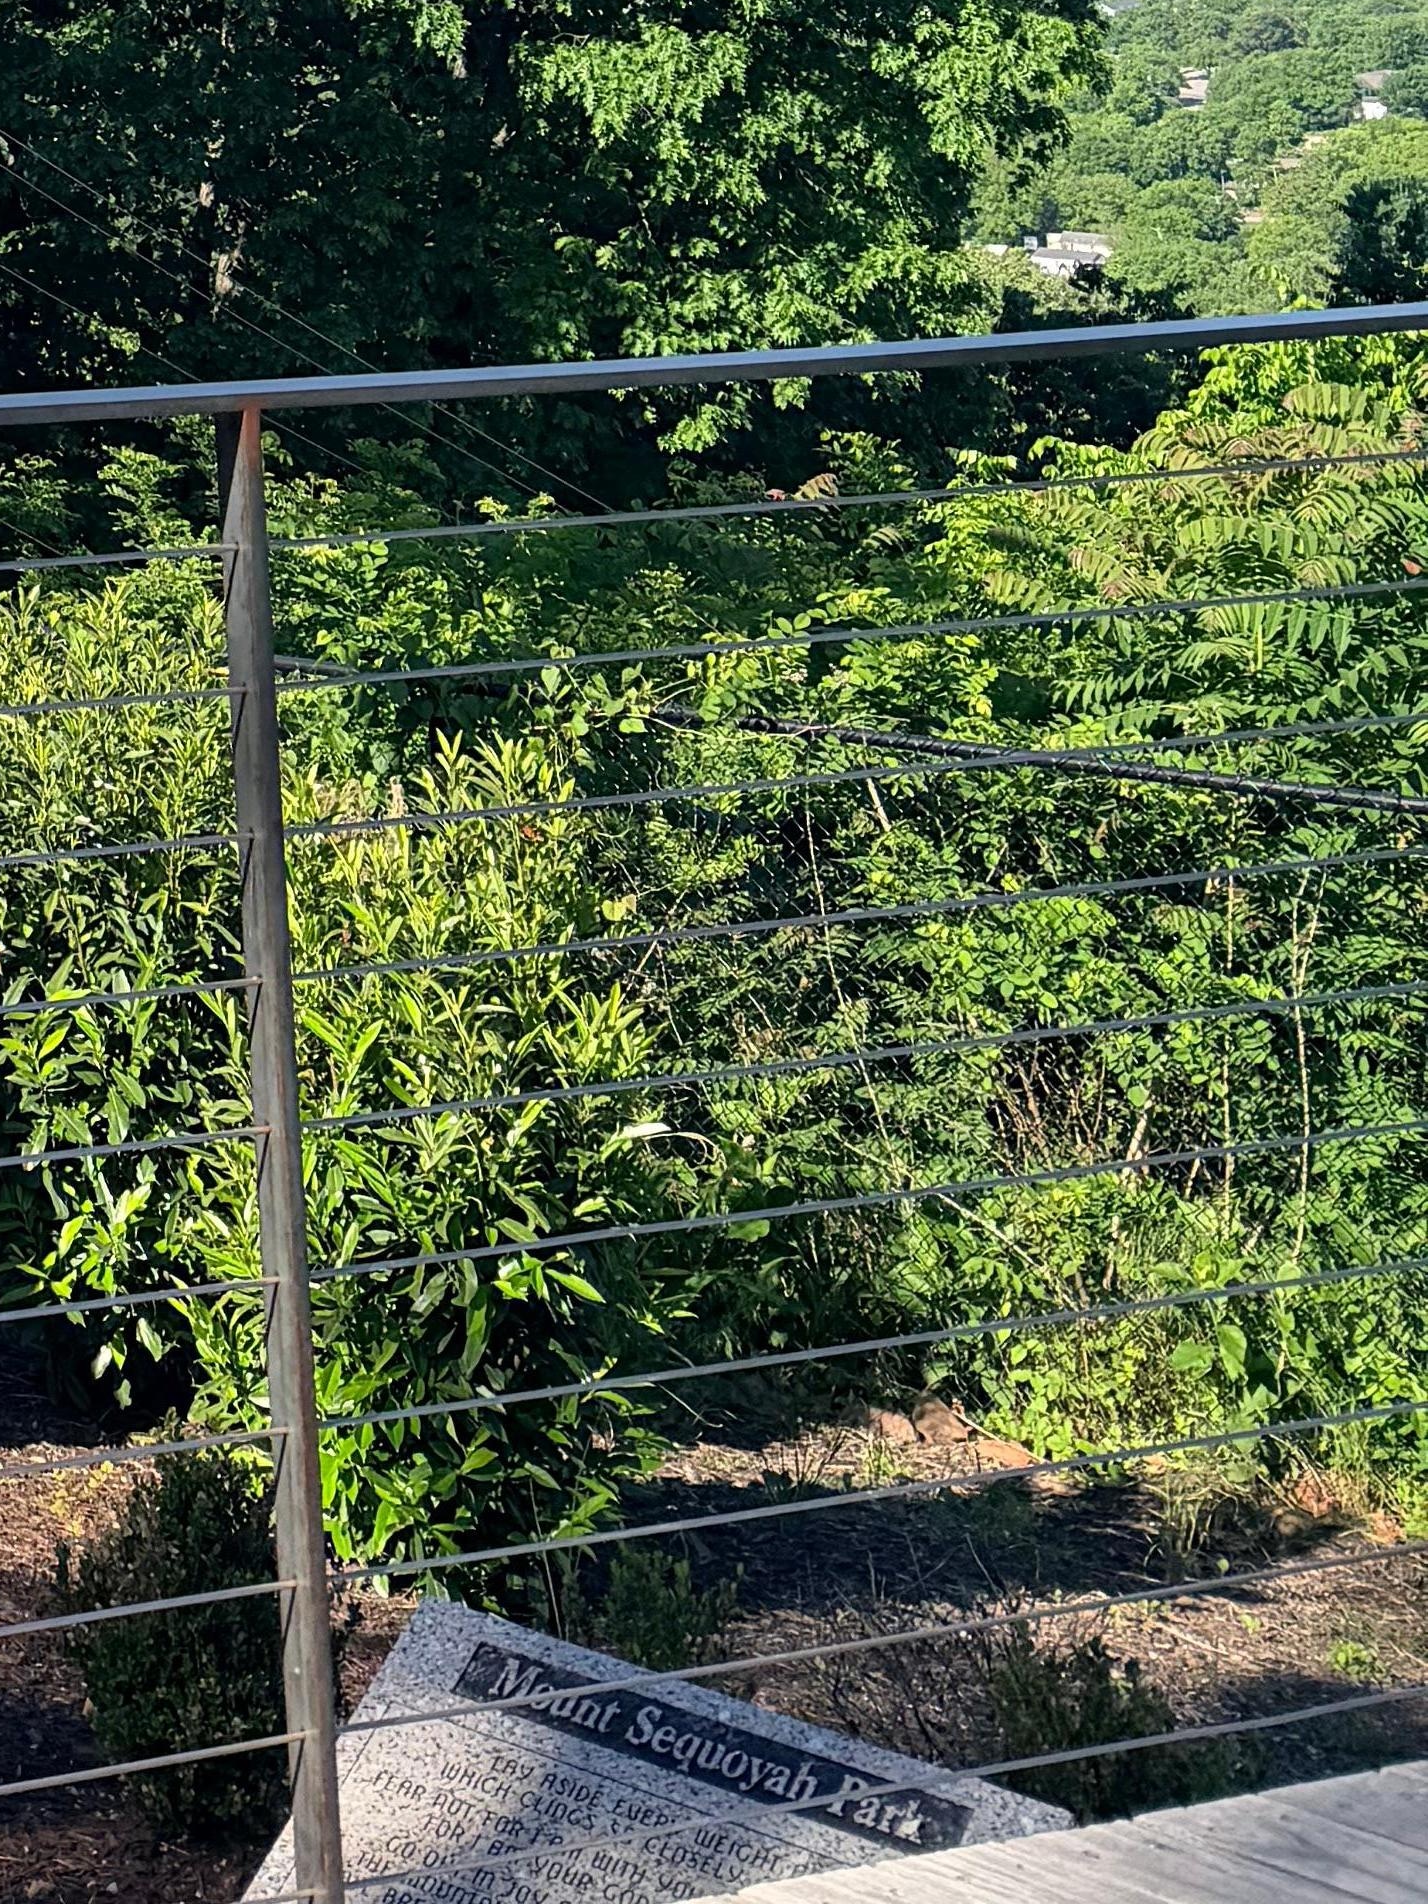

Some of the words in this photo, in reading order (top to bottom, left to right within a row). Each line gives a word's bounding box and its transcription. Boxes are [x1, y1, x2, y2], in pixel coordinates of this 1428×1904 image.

[488, 1658, 621, 1732] Mount
[625, 1704, 820, 1802] Sequoyah
[826, 1774, 922, 1844] Park
[372, 1769, 427, 1801] FEAR
[482, 1809, 524, 1839] FOR
[591, 1851, 647, 1888] WITH
[440, 1761, 511, 1801] WHICH
[519, 1790, 598, 1831] CLINGS
[490, 1755, 535, 1780] LAY
[540, 1773, 603, 1811] ASIDE
[611, 1798, 678, 1829] EVER
[386, 1835, 417, 1859] GO
[422, 1813, 465, 1844] FOR
[530, 1855, 597, 1891] YOUR
